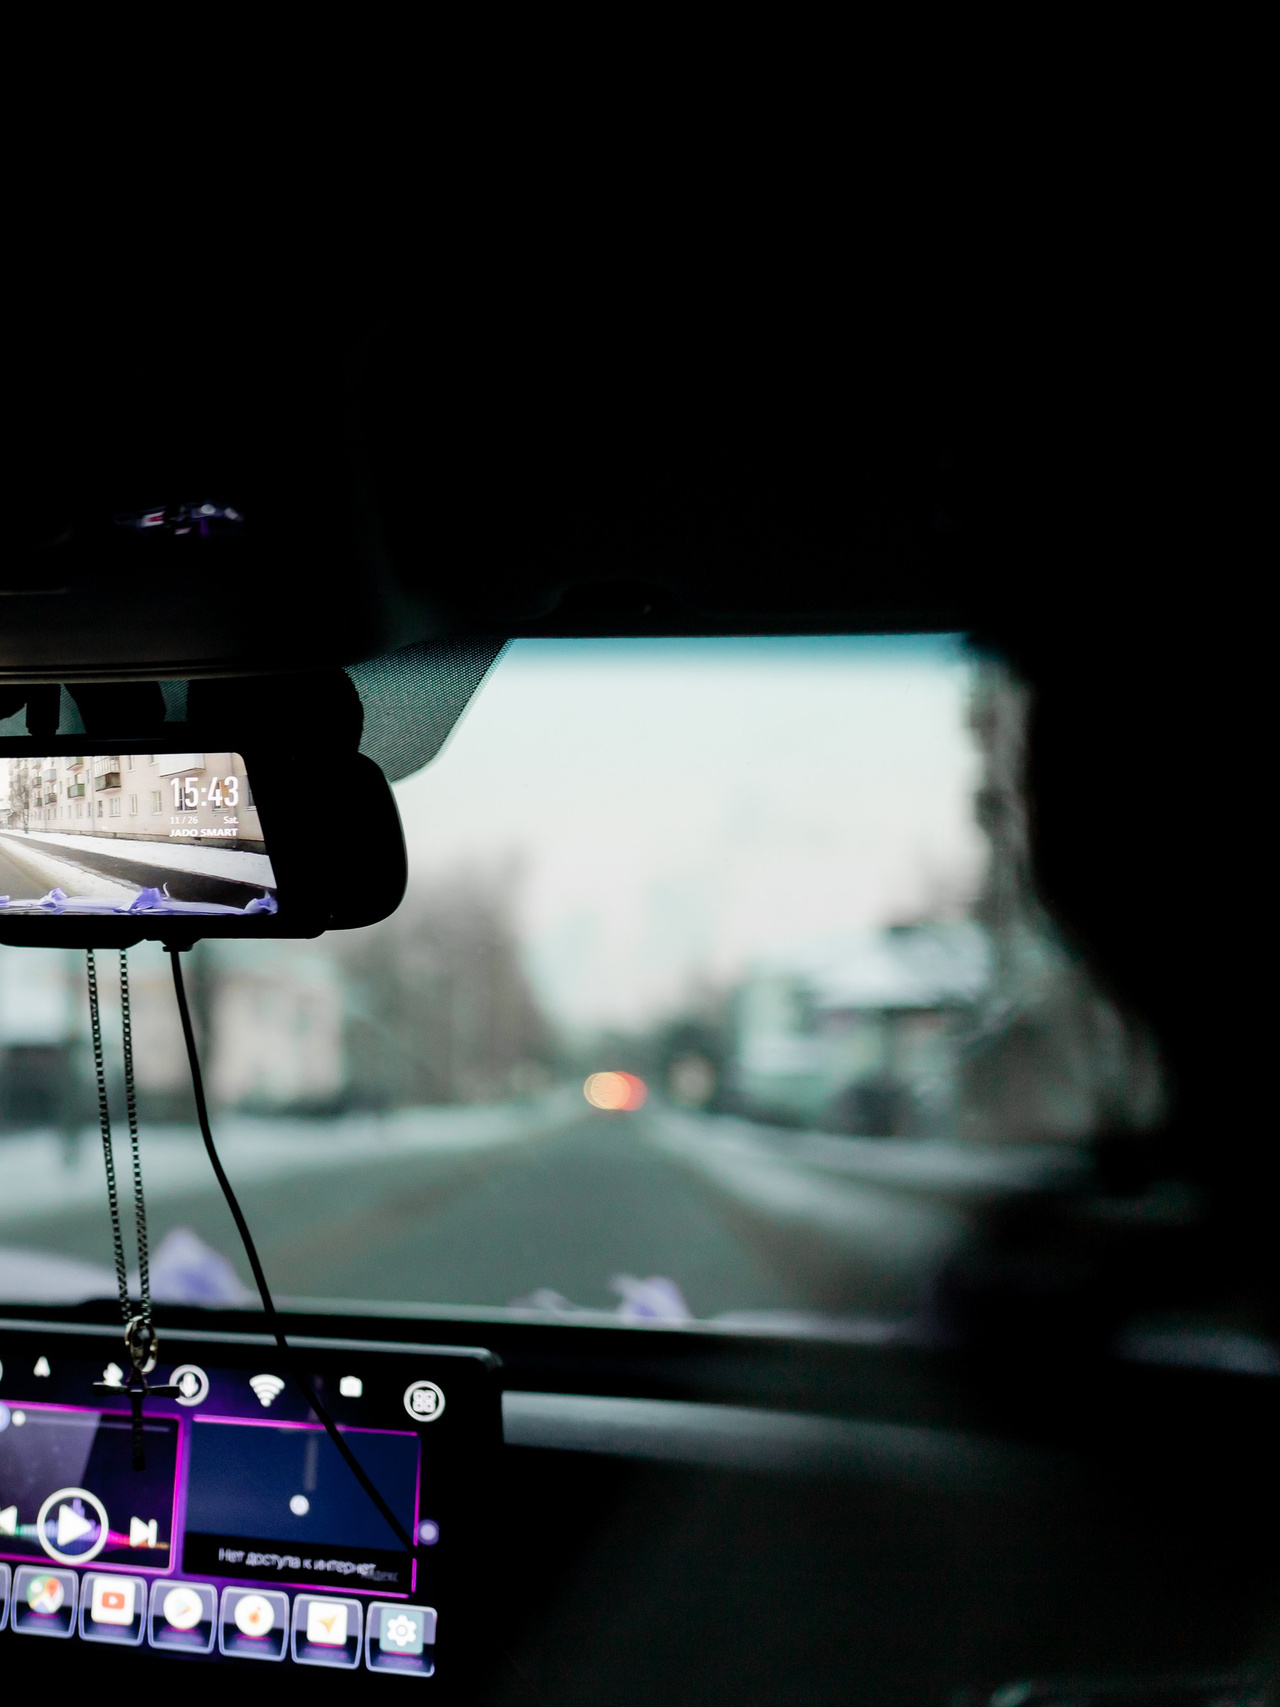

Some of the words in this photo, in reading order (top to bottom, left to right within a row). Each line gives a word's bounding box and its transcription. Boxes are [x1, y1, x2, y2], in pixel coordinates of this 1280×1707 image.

[170, 776, 238, 807] 15:43
[169, 828, 198, 837] JADO
[200, 828, 238, 836] SMART
[218, 1547, 245, 1564] Нет
[245, 1551, 301, 1571] доступа
[302, 1558, 312, 1570] к
